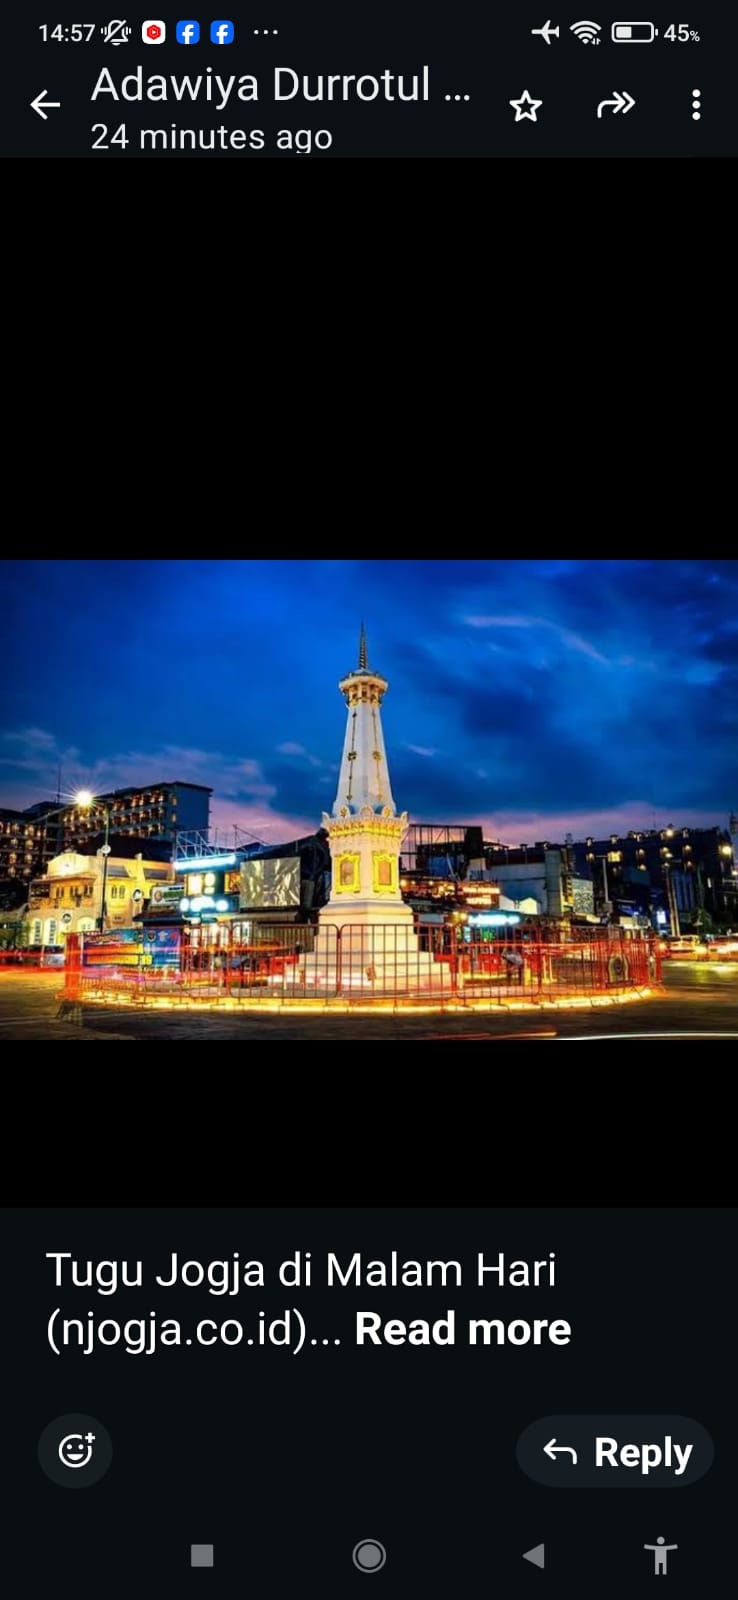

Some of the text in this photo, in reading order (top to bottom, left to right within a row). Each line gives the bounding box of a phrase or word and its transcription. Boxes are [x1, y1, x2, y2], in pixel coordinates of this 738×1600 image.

[38, 23, 96, 42] 14:57
[663, 23, 701, 42] 45%
[90, 65, 259, 111] Adawiya
[274, 65, 429, 102] Durrotul
[91, 123, 333, 154] 24 minutes ago
[46, 1250, 556, 1296] Tugu Jogja di Malam Hari
[46, 1307, 572, 1356] (njogja.co.id)... Read more
[595, 1435, 694, 1476] Reply
